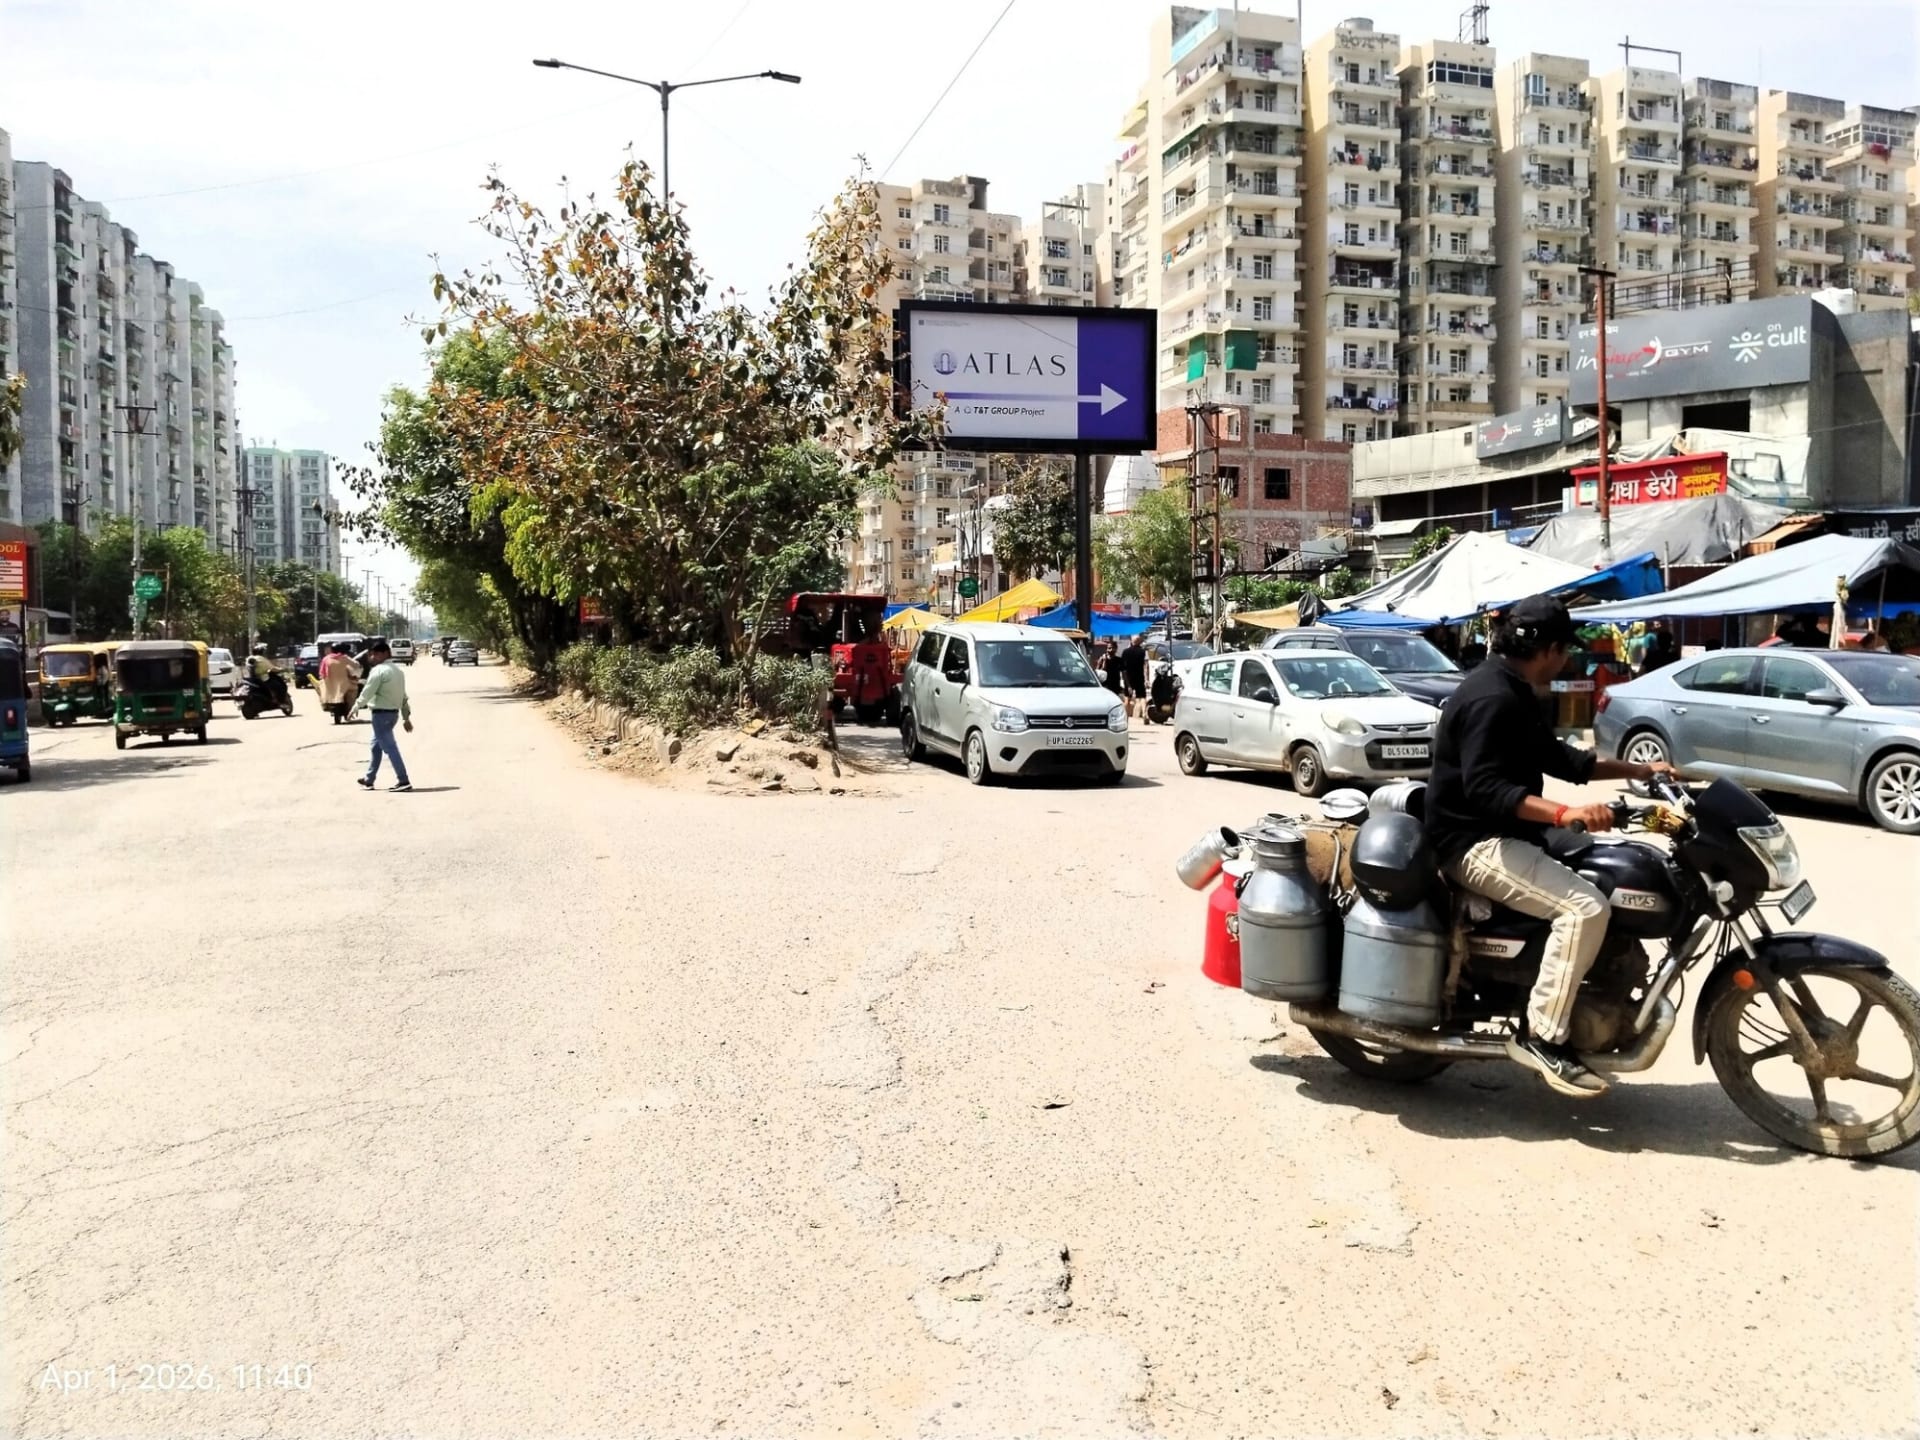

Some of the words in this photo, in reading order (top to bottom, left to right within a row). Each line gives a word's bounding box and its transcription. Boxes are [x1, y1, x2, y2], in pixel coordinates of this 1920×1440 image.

[1767, 323, 1782, 332] on
[1767, 325, 1807, 348] cult
[1665, 345, 1709, 358] GYM
[963, 352, 1067, 376] ATLAS
[954, 406, 961, 414] A
[974, 406, 989, 415] T&T
[990, 406, 1020, 416] GROUP
[1021, 407, 1046, 418] Project
[1643, 469, 1678, 497] डेरी
[1621, 894, 1656, 908] TVS
